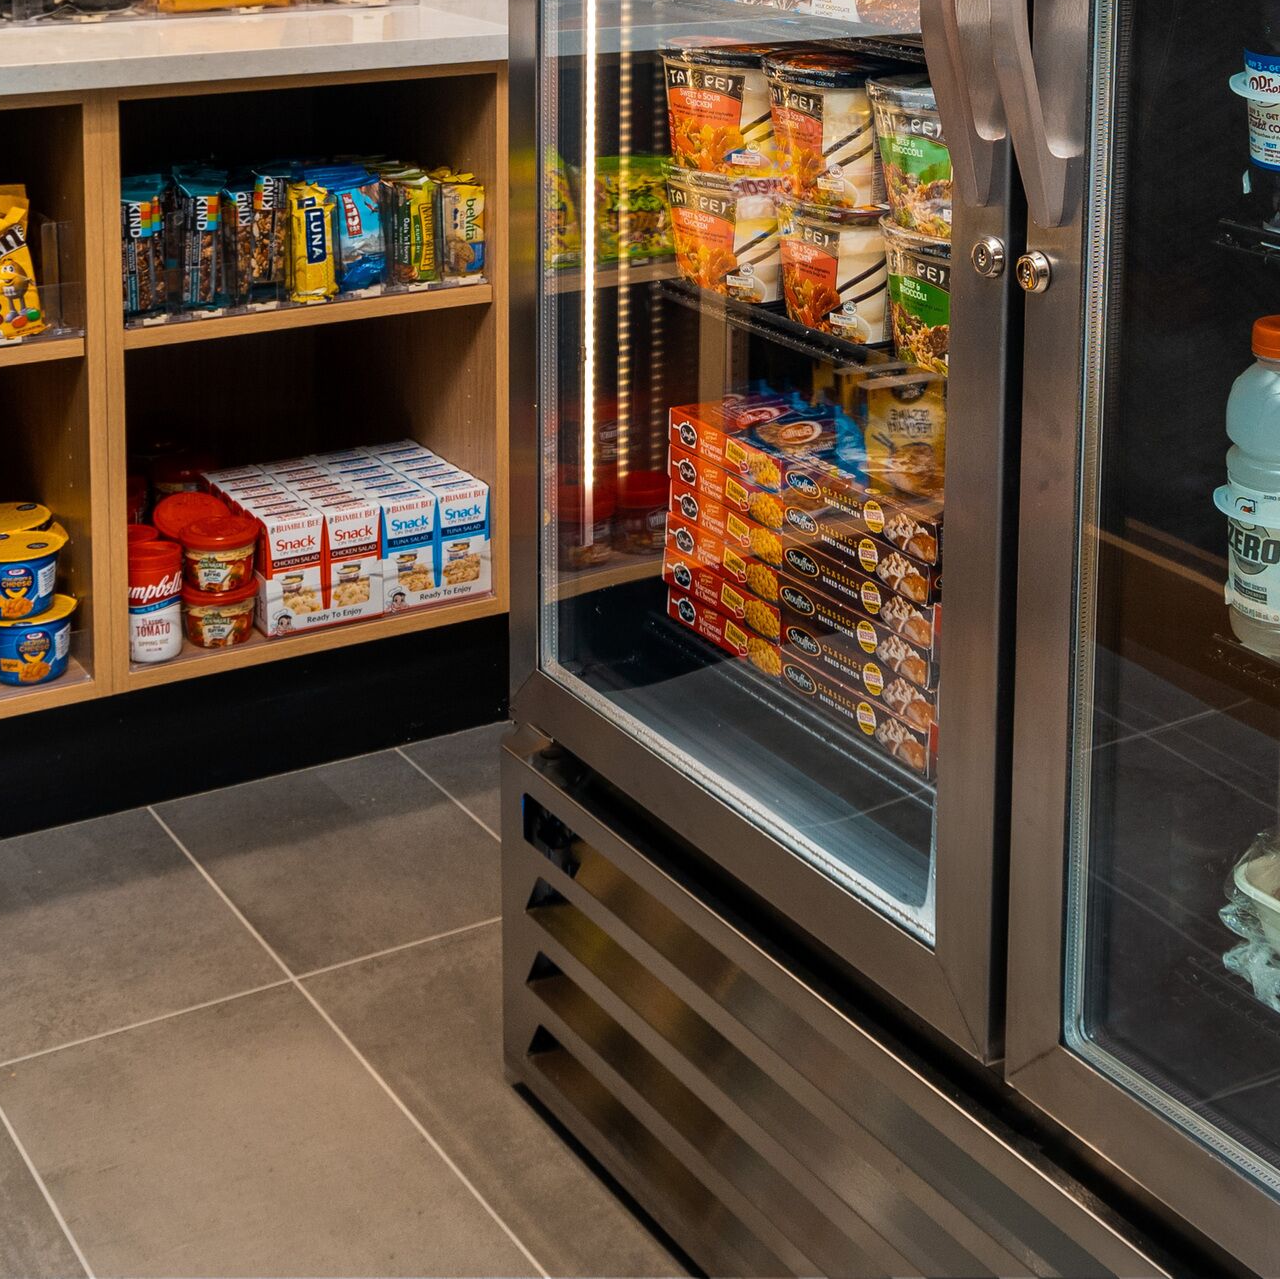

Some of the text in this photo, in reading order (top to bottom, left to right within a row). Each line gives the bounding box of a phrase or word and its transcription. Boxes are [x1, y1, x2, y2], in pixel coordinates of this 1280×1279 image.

[893, 144, 923, 158] BROCCOLI
[129, 201, 142, 239] KIND
[196, 195, 207, 232] KIND
[465, 198, 476, 241] belVita
[309, 209, 323, 261] LUNA
[789, 473, 817, 495] Stouffer's
[444, 503, 481, 521] Snack
[788, 509, 815, 532] Stouffer's
[391, 514, 429, 532] Snack
[334, 525, 373, 542] Snack
[275, 534, 316, 552] Snack
[331, 543, 377, 558] CHICKEN SALAD
[273, 553, 320, 568] CHICKEN SALAD
[419, 584, 472, 601] Ready To Enjoy
[306, 606, 363, 624] Ready To Enjoy
[136, 622, 170, 638] TOMATO
